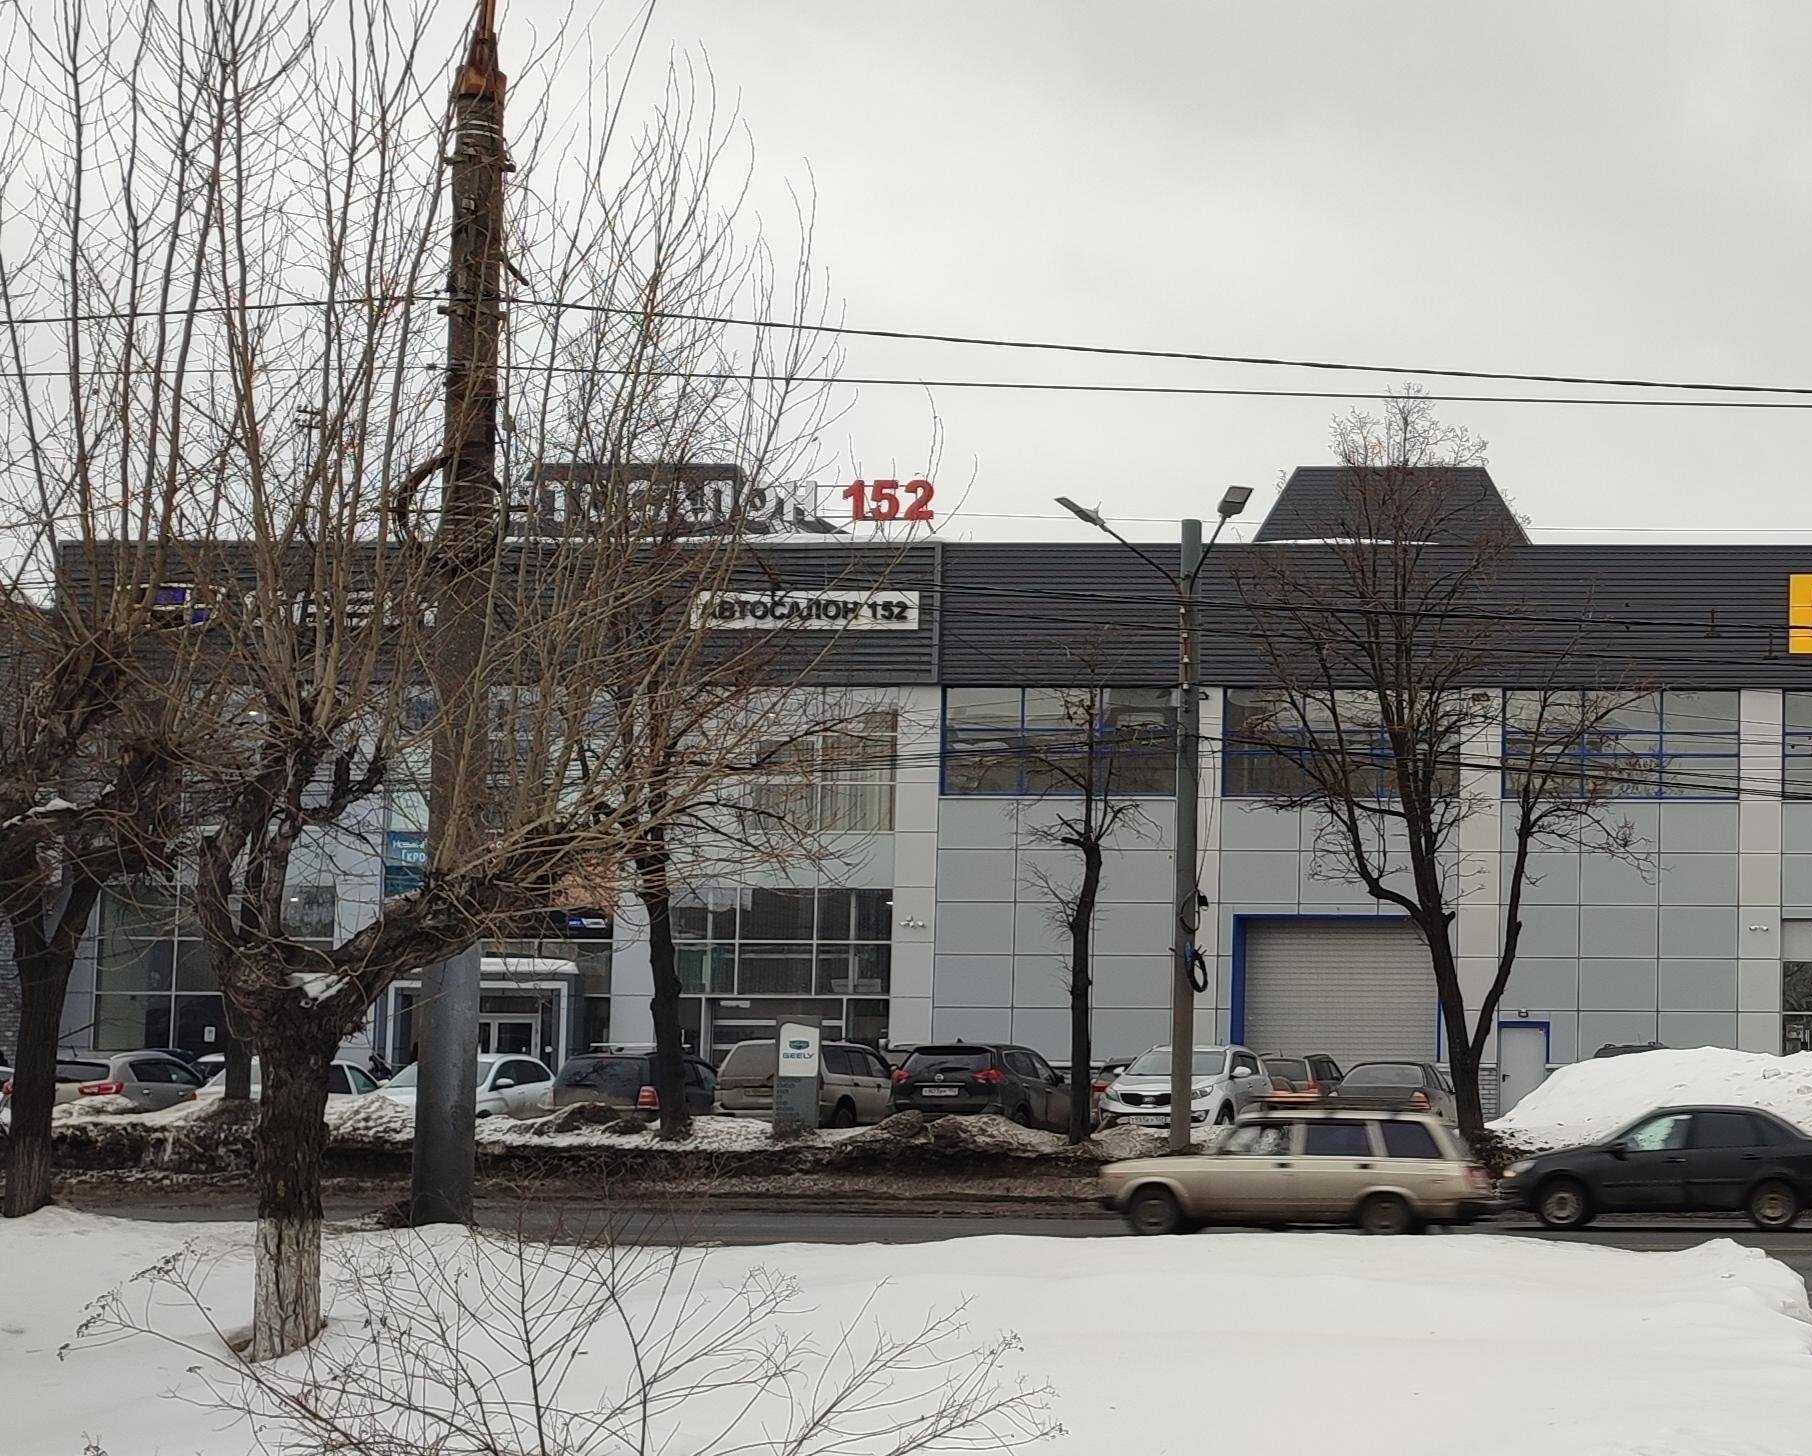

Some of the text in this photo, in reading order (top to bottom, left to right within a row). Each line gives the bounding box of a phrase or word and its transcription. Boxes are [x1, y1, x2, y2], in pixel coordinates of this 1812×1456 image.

[842, 479, 935, 522] 152
[867, 599, 908, 621] 152
[782, 1052, 816, 1060] GEELY
